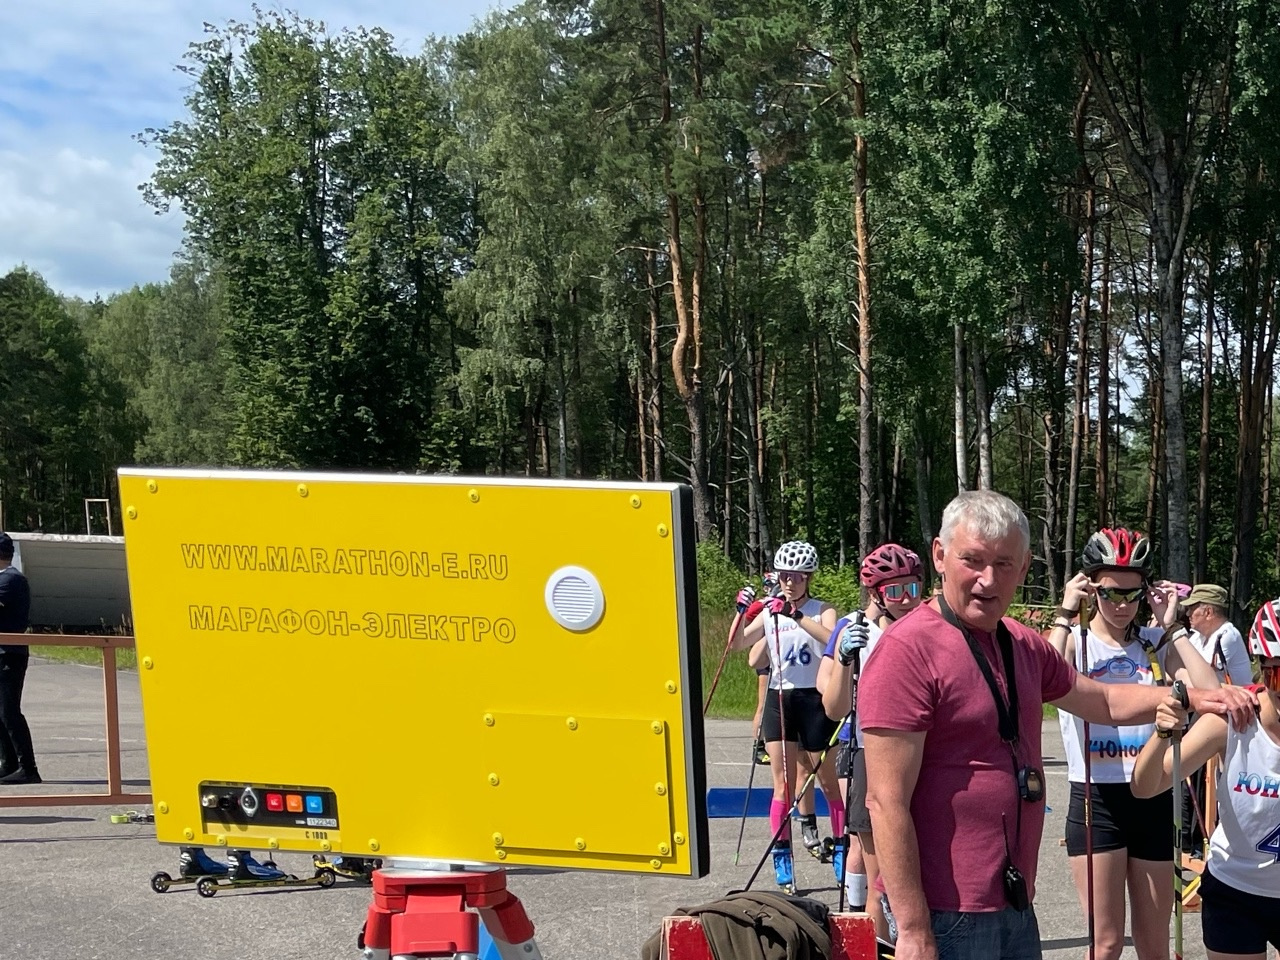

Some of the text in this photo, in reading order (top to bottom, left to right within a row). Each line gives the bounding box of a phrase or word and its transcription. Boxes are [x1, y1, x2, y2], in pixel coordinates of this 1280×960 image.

[181, 543, 508, 581] WWW.MARATHON-E.RU
[188, 604, 516, 644] МАРАФОН-ЭЛЕКТРО
[784, 643, 811, 667] 46
